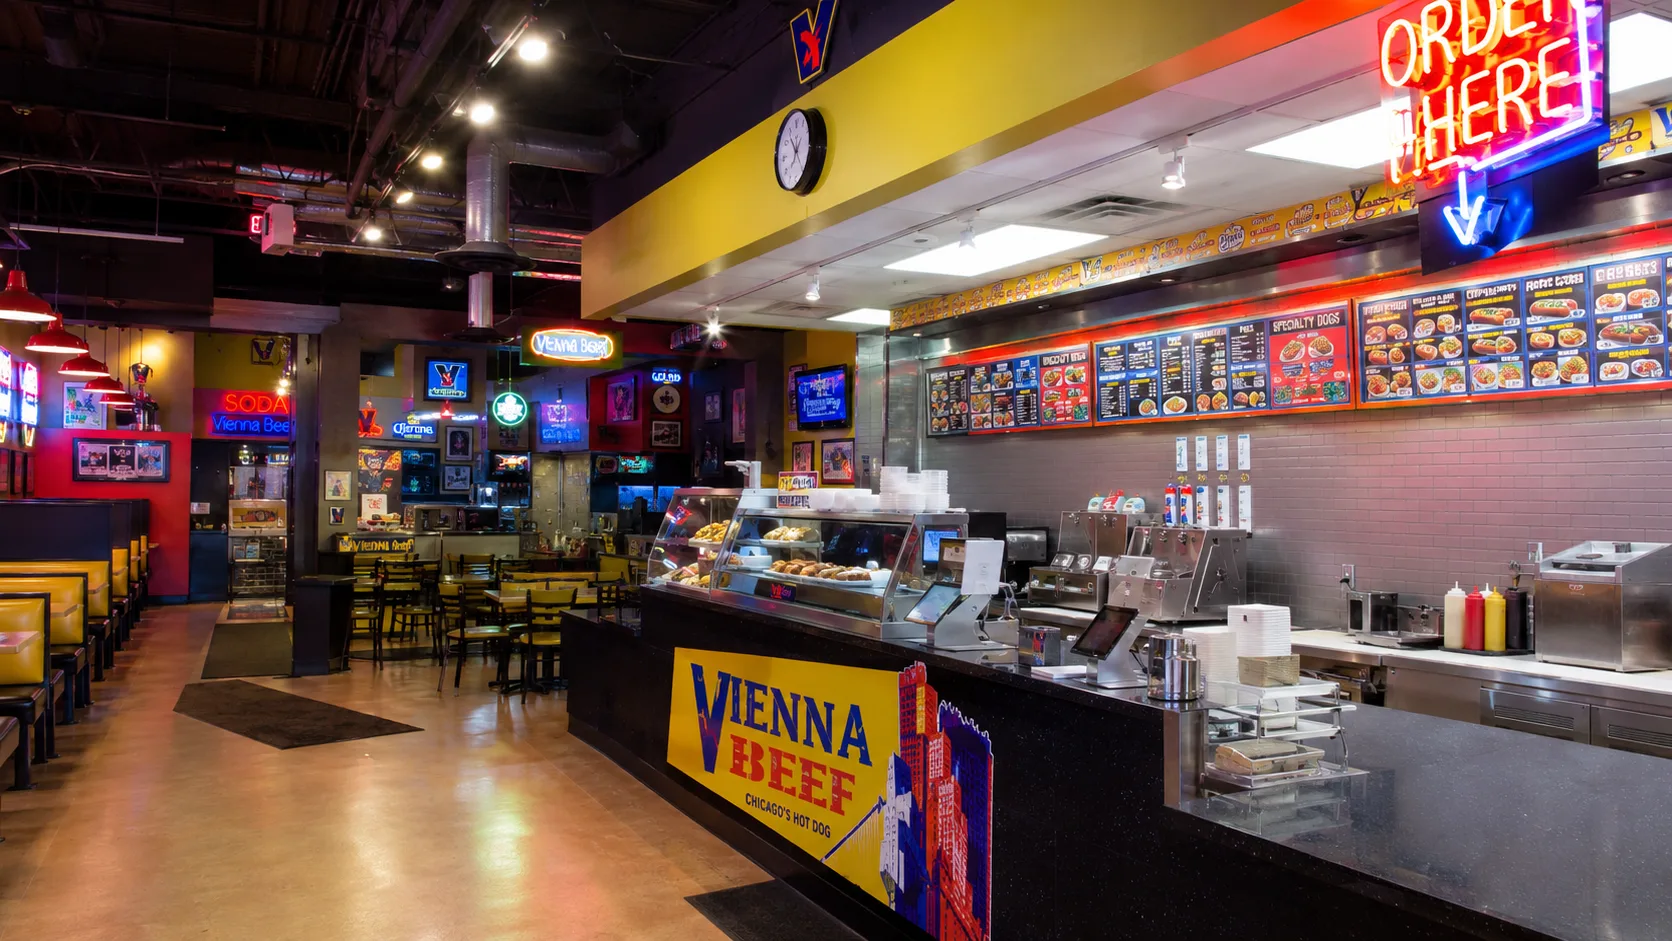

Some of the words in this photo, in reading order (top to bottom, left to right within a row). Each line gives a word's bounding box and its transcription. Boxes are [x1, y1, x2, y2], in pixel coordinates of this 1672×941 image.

[1382, 0, 1554, 86] ORDE
[1423, 38, 1573, 161] HERE
[212, 415, 261, 433] Vienna
[263, 416, 291, 433] Bee
[225, 393, 290, 414] SODA
[690, 663, 873, 774] VIENNA
[729, 733, 856, 817] BEEF
[745, 792, 791, 822] CHICAGO'S
[793, 811, 810, 830] HOT
[812, 819, 831, 839] DOG
